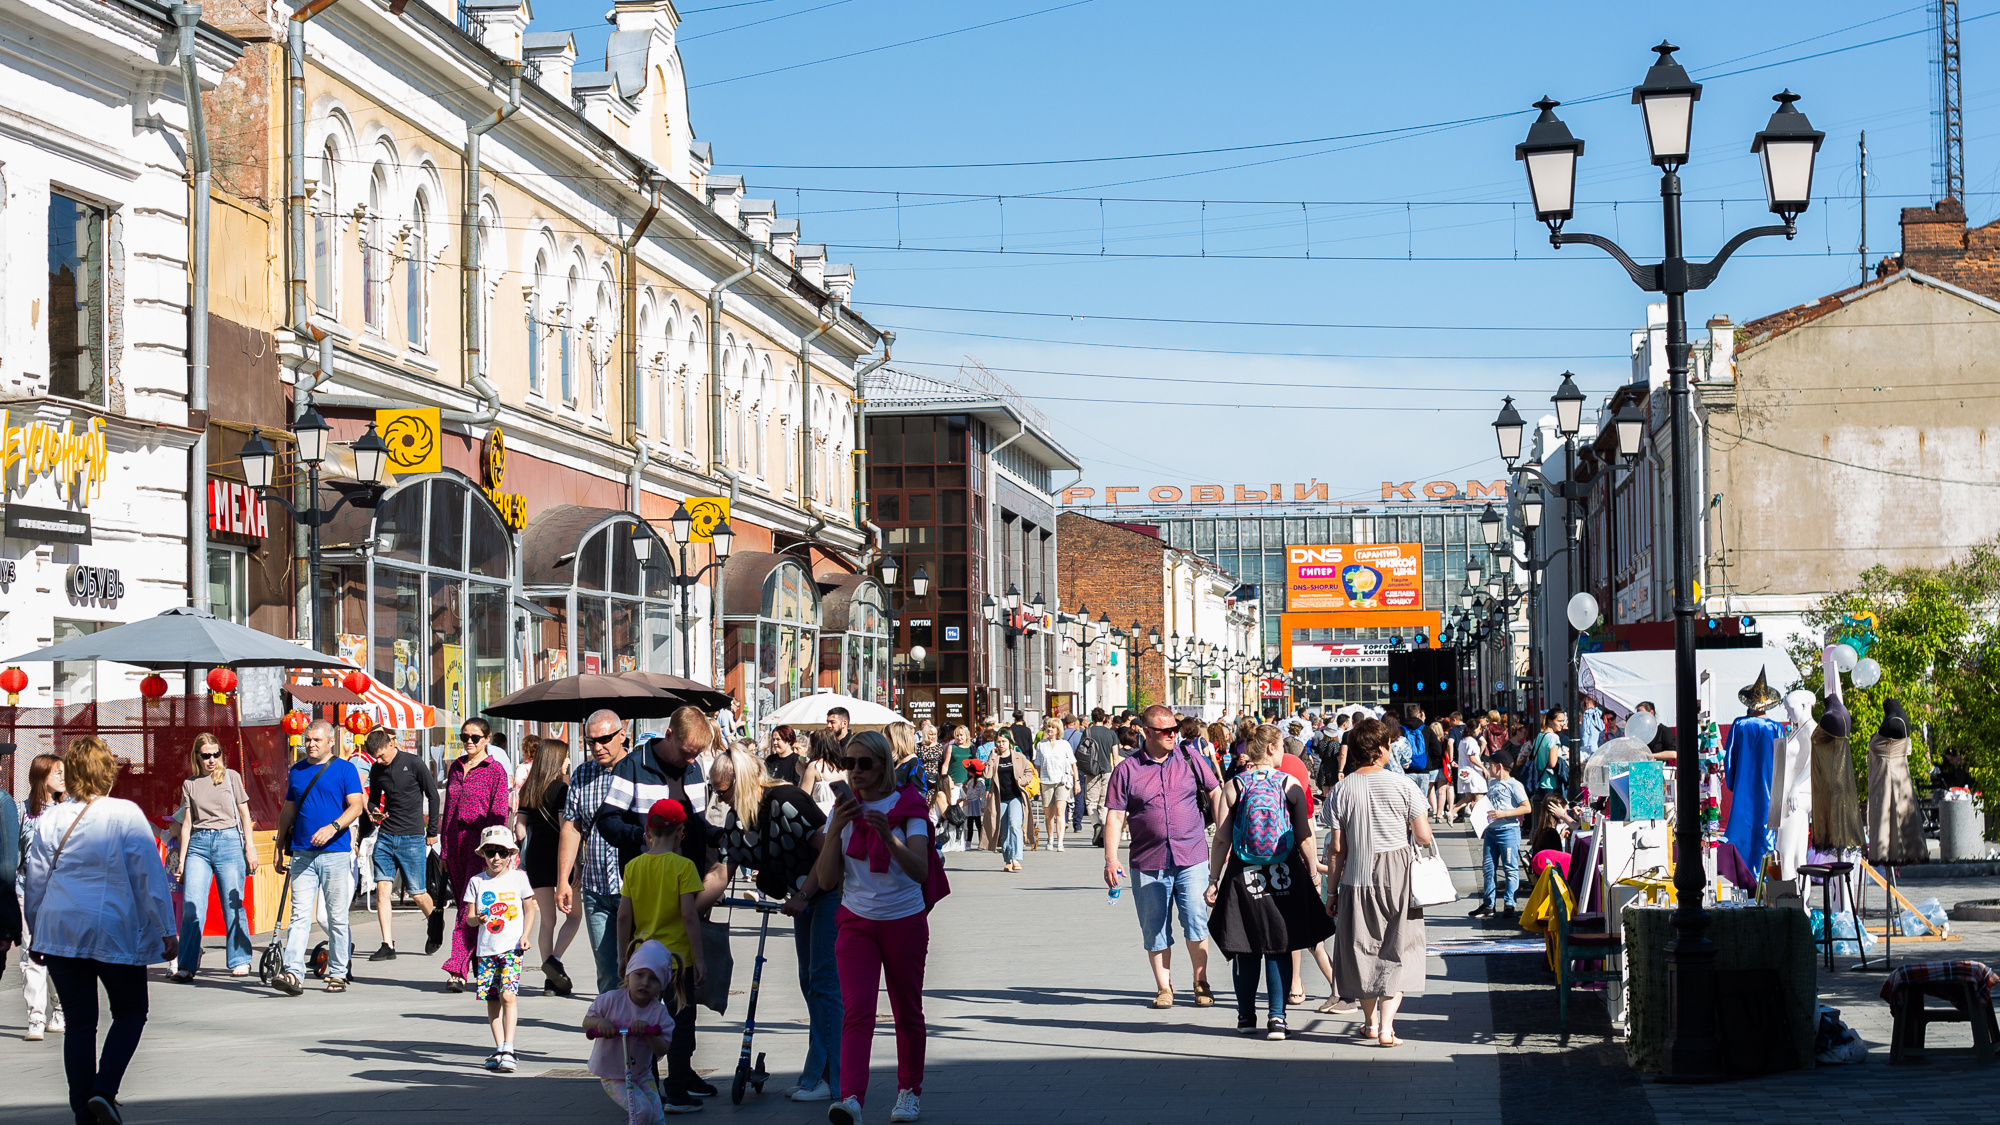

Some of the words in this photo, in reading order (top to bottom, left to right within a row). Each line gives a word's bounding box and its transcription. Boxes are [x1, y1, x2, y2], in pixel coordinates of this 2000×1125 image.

[214, 479, 269, 538] МЕХА
[514, 493, 527, 530] 38
[1290, 548, 1343, 563] DNS
[1357, 549, 1398, 559] ГАРАНТИЯ
[1375, 556, 1416, 568] НИЗКОЙ
[1301, 567, 1333, 576] ГИПЕР
[1393, 567, 1416, 576] ЦЕНЫ
[74, 565, 125, 600] ОБУВЬ
[910, 619, 931, 627] КУРТКИ
[1243, 863, 1292, 893] 58
